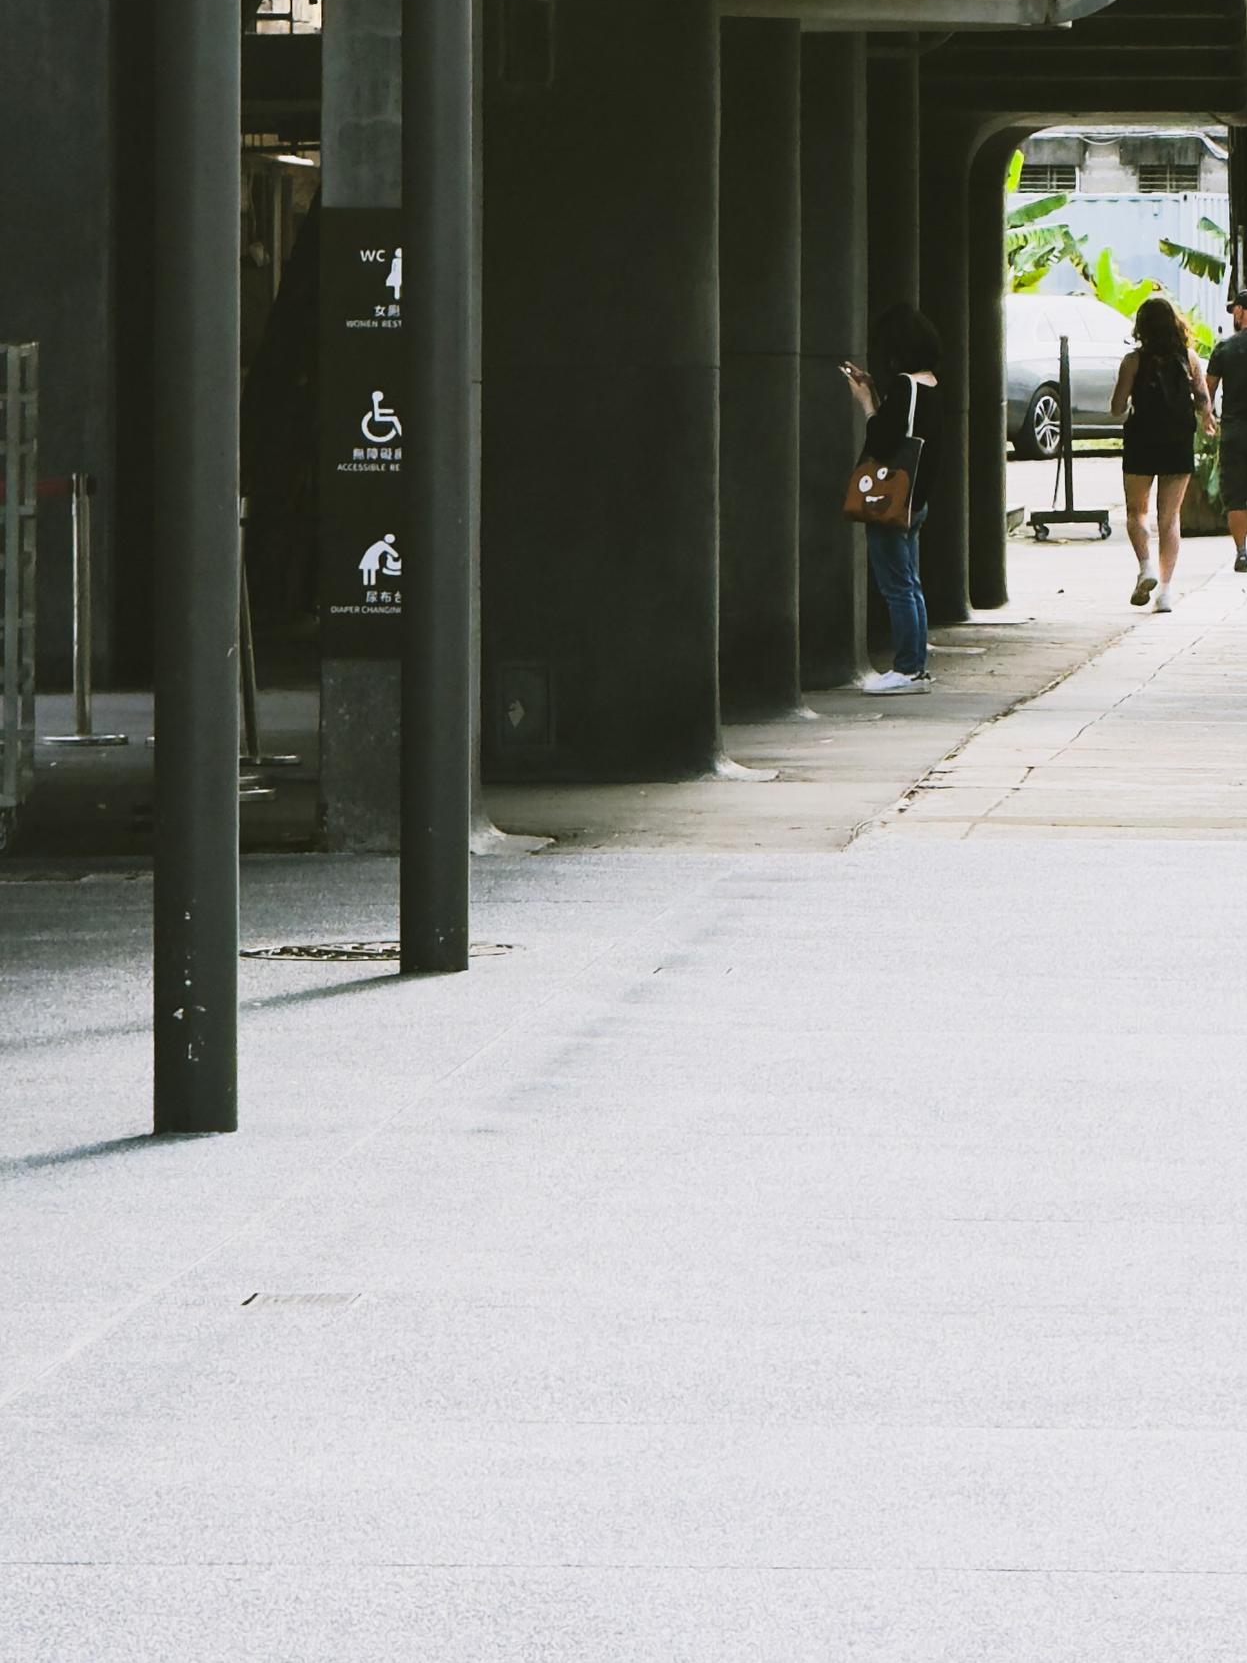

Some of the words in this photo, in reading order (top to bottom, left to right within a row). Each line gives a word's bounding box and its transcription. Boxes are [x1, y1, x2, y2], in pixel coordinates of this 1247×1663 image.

[360, 250, 385, 262] WC
[337, 464, 386, 472] ACCESSIBLE
[330, 606, 360, 614] DIAPER
